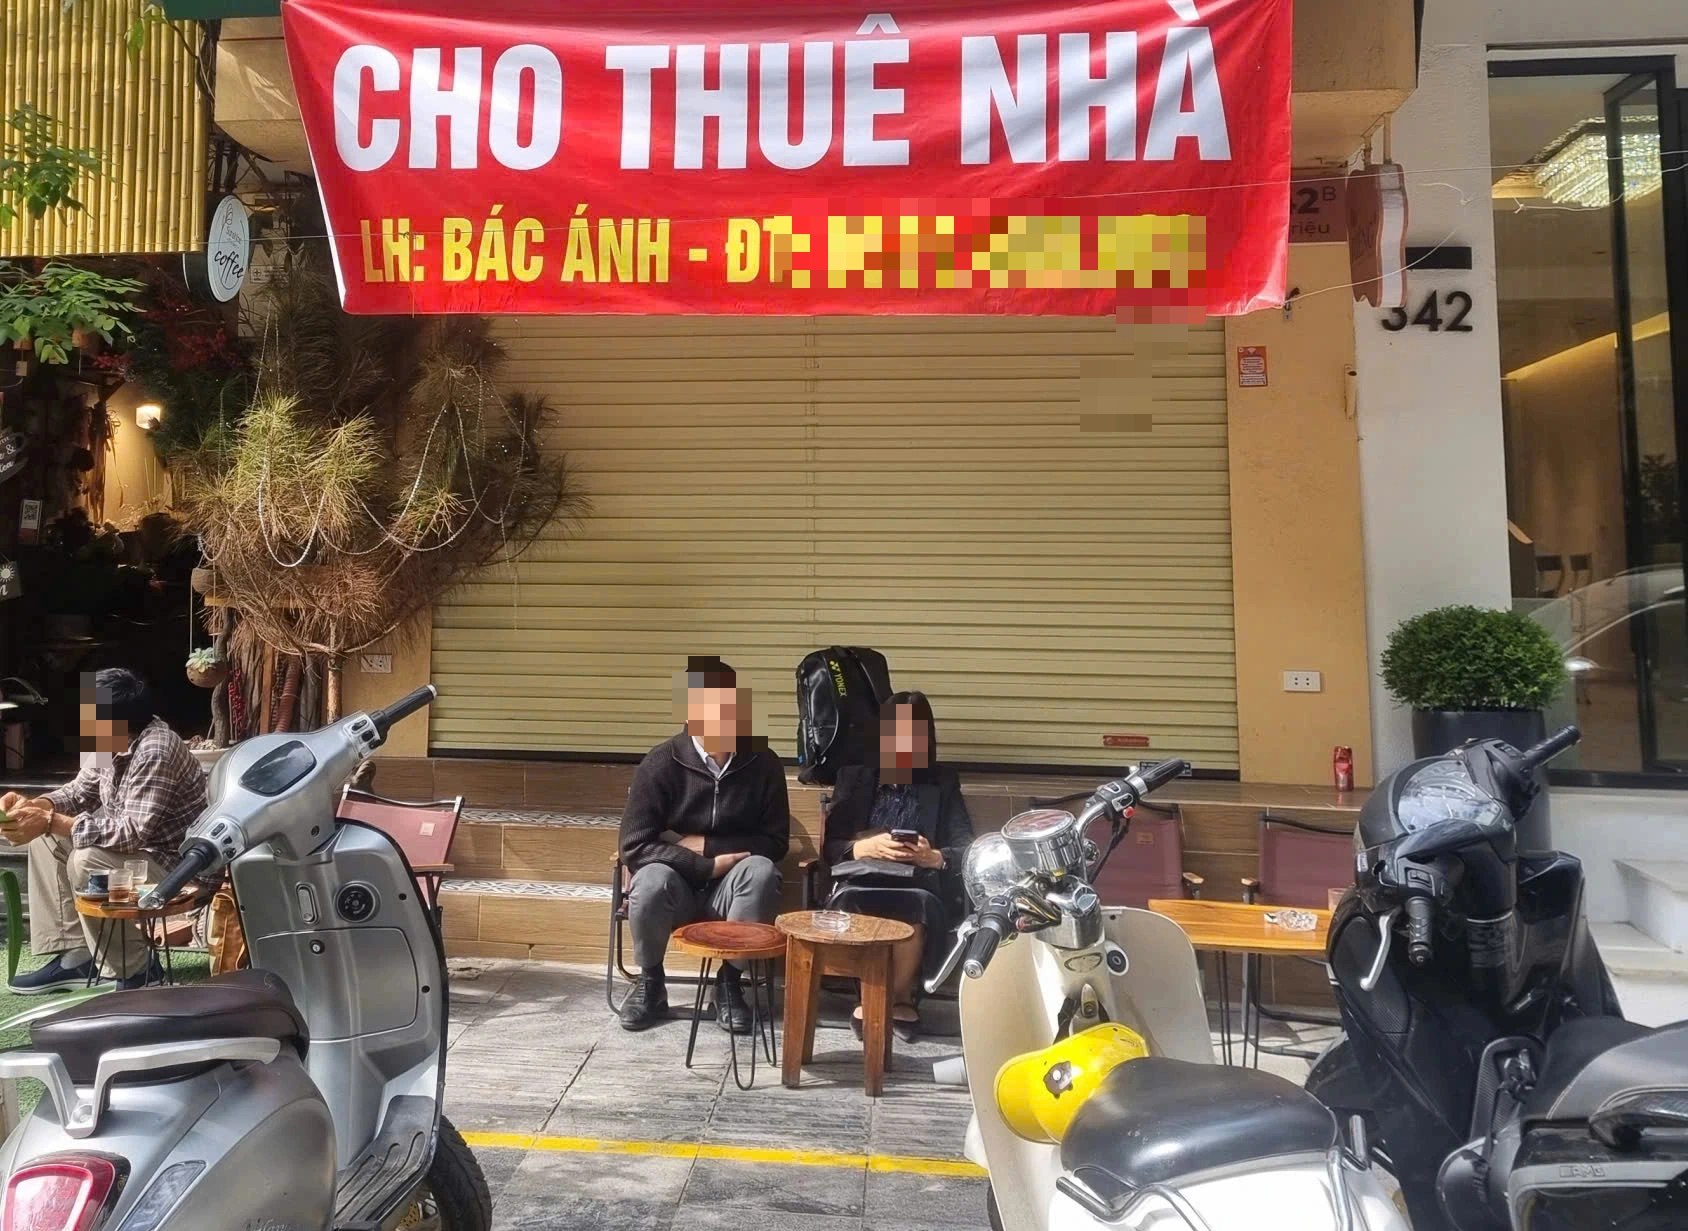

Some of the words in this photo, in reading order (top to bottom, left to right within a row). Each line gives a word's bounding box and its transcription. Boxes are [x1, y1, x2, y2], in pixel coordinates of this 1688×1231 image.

[333, 44, 563, 172] CHO
[605, 13, 910, 170] THUÊ
[961, 0, 1232, 165] NHÀ
[360, 218, 424, 282] LH:
[443, 204, 544, 282] BÁC
[560, 203, 671, 283] ÁNH
[688, 248, 708, 262] -
[1291, 220, 1330, 237] riệu
[214, 250, 243, 284] coffee
[834, 673, 848, 697] YONEX
